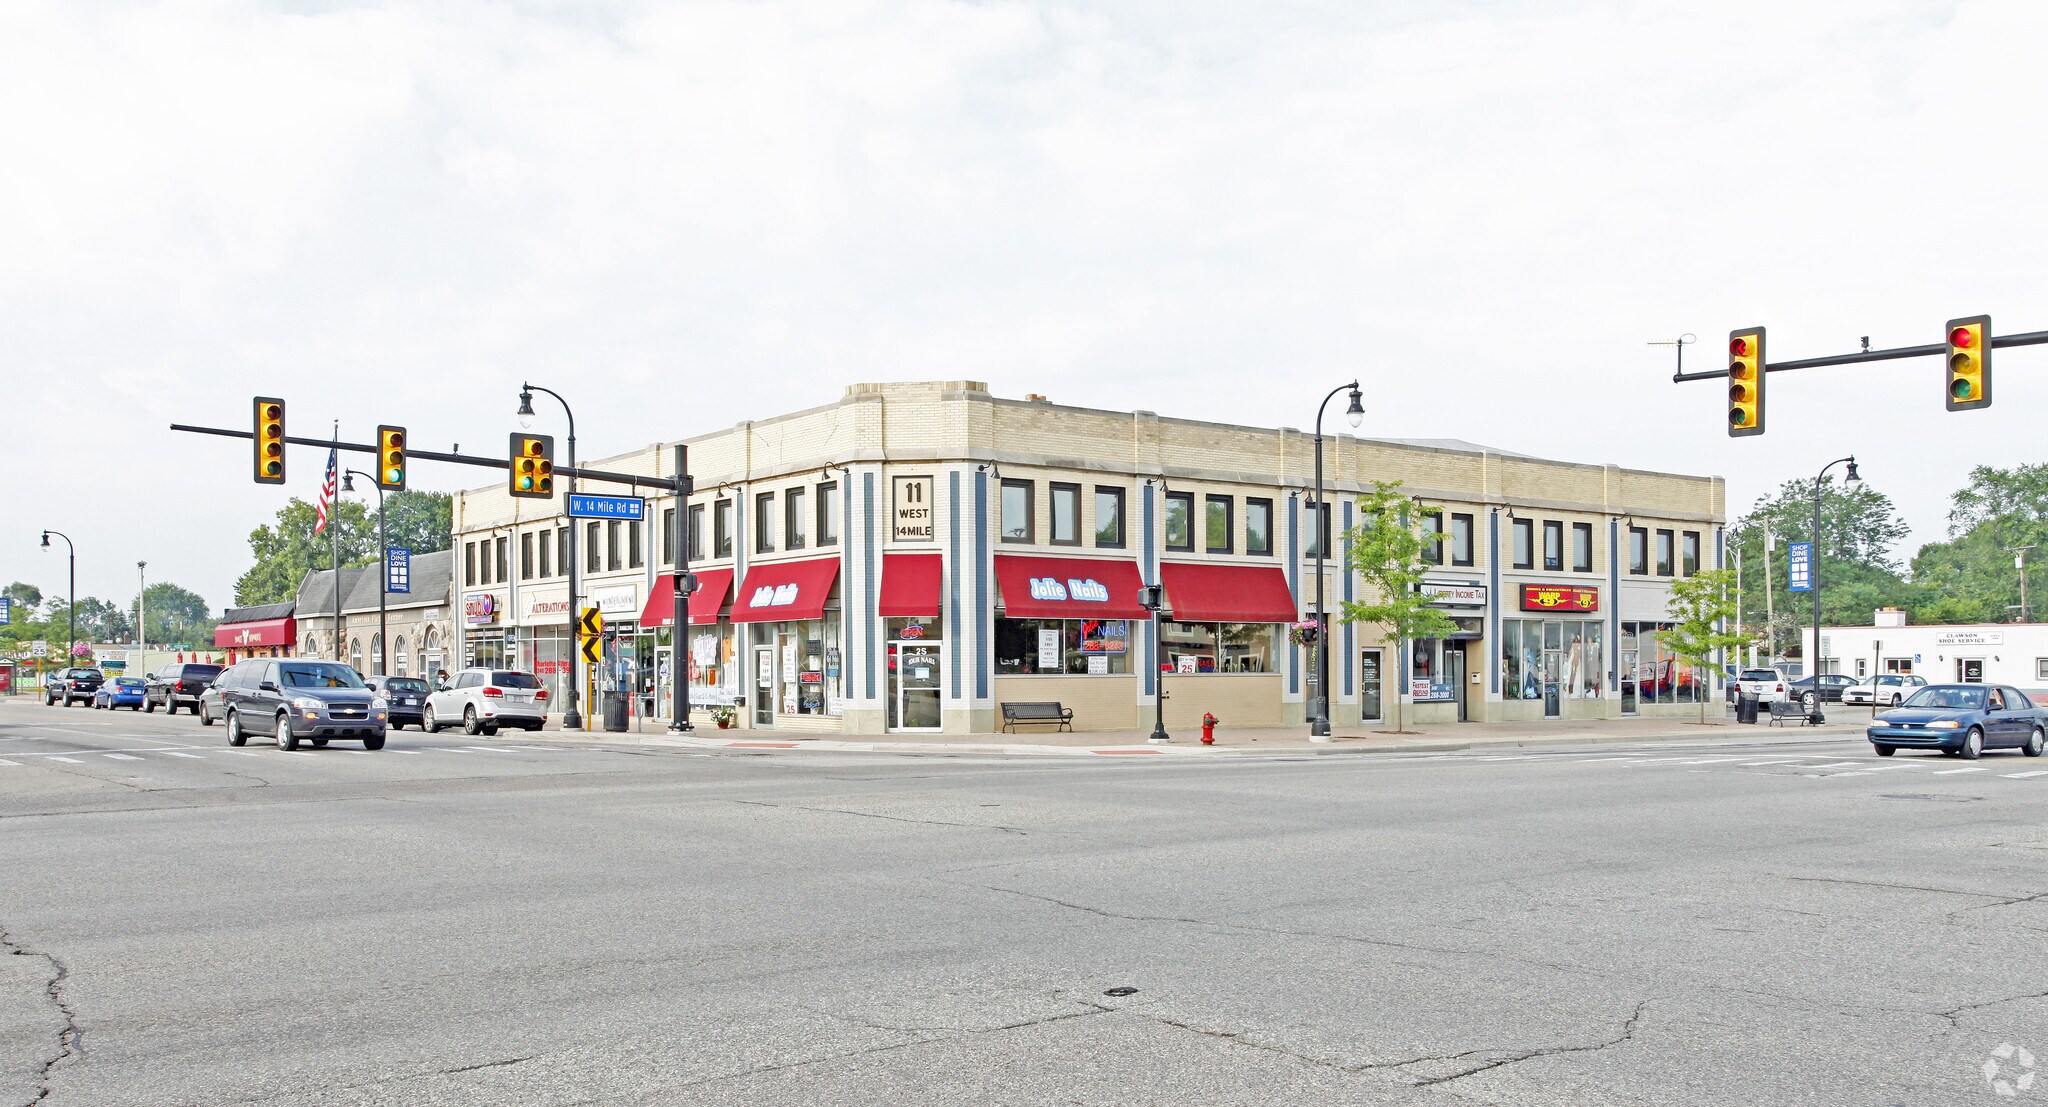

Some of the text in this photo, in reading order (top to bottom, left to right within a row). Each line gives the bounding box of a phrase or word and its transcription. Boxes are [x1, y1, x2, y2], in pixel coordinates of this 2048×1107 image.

[906, 482, 922, 503] 11
[574, 500, 626, 514] W. 14 Mile Rd
[899, 508, 928, 518] WEST
[1031, 580, 1107, 600] Jolie Nails
[1456, 590, 1474, 598] INCOME
[1475, 590, 1484, 599] TAX
[532, 602, 570, 614] ALTERATIONS
[900, 628, 924, 637] OPEN
[1098, 626, 1124, 636] NAILS
[920, 656, 935, 665] NAILS
[1182, 665, 1192, 673] 25
[787, 705, 795, 714] 25
